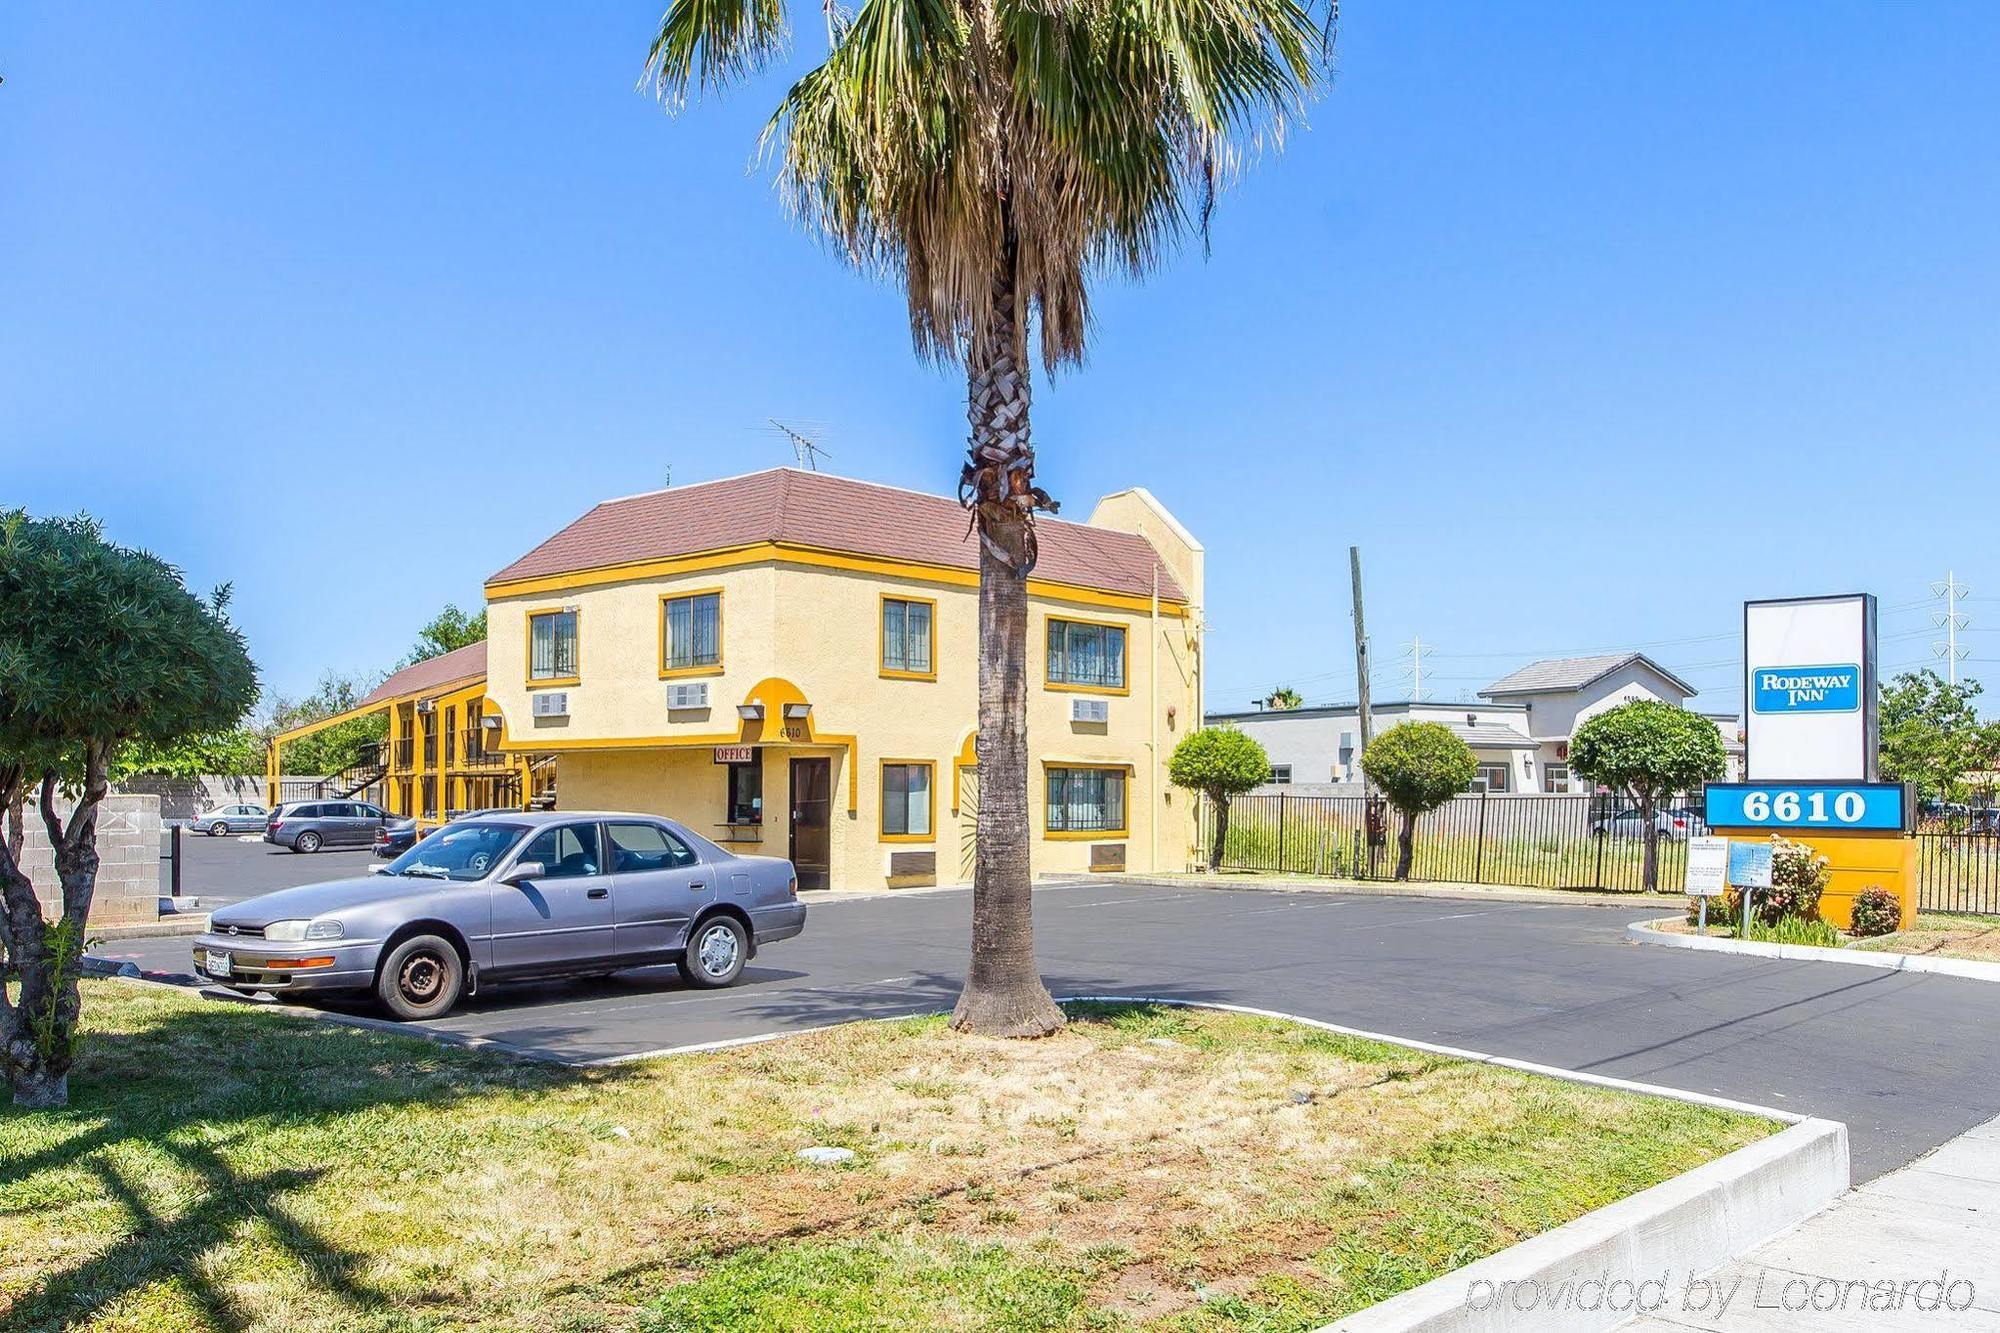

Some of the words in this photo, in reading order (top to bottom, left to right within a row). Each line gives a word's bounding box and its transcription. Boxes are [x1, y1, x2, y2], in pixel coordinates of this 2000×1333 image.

[1761, 674, 1851, 690] RODEWAY
[1787, 689, 1825, 706] INN
[717, 747, 752, 760] OFFICE
[1743, 791, 1866, 822] 6610
